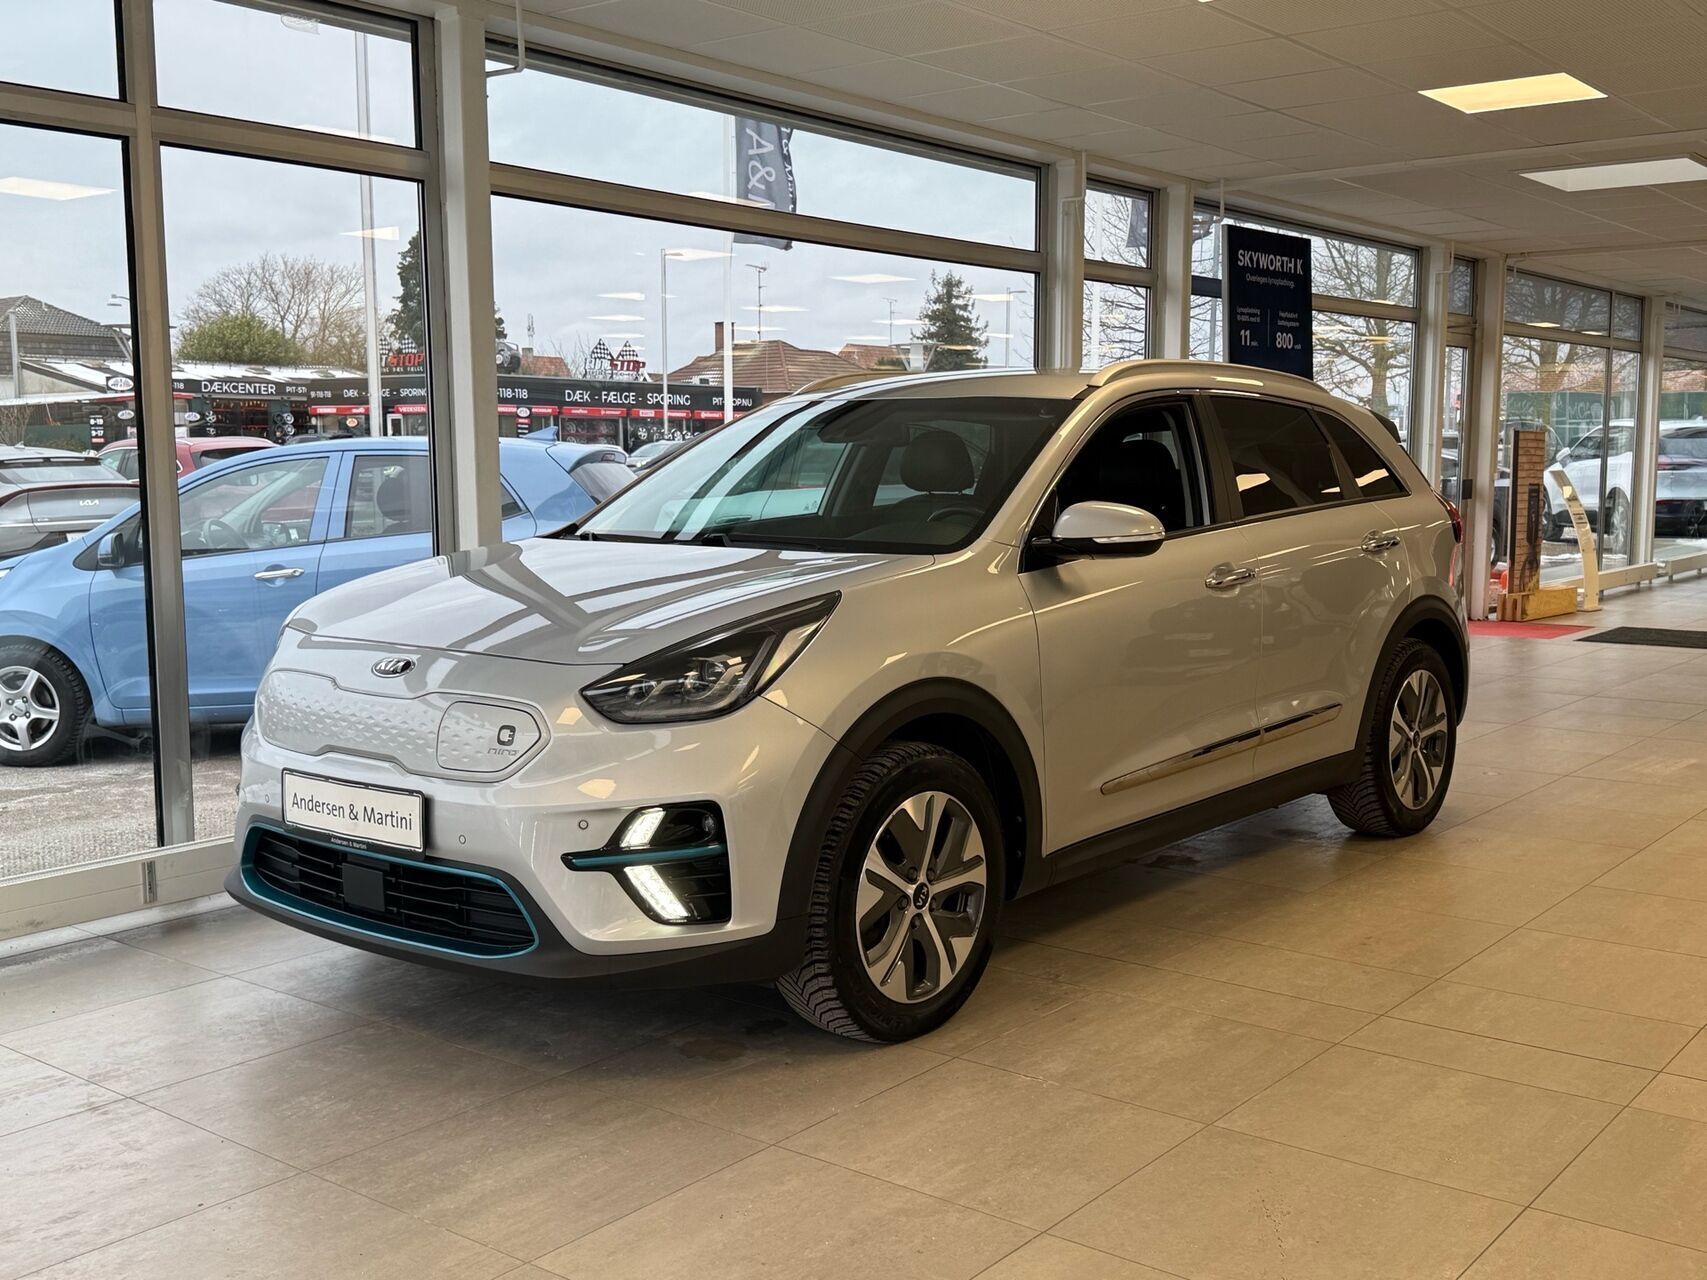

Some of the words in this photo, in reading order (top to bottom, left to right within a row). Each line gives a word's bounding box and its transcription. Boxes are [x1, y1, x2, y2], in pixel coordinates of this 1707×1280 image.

[1237, 249, 1294, 274] SKYWORTH
[1296, 259, 1304, 275] K
[1240, 329, 1250, 346] 11
[1275, 332, 1294, 349] 800
[201, 381, 276, 395] DÆKCENTER
[343, 388, 359, 398] DÆK
[564, 389, 591, 402] DÆK
[601, 391, 636, 404] FÆLGE
[646, 393, 691, 406] SPORING
[712, 396, 753, 407] PIT-OP.NU
[376, 658, 406, 672] KIA
[487, 747, 518, 757] niro
[291, 792, 345, 819] Andersen
[349, 803, 359, 822] &
[363, 806, 413, 831] Martini
[916, 886, 928, 905] KIA
